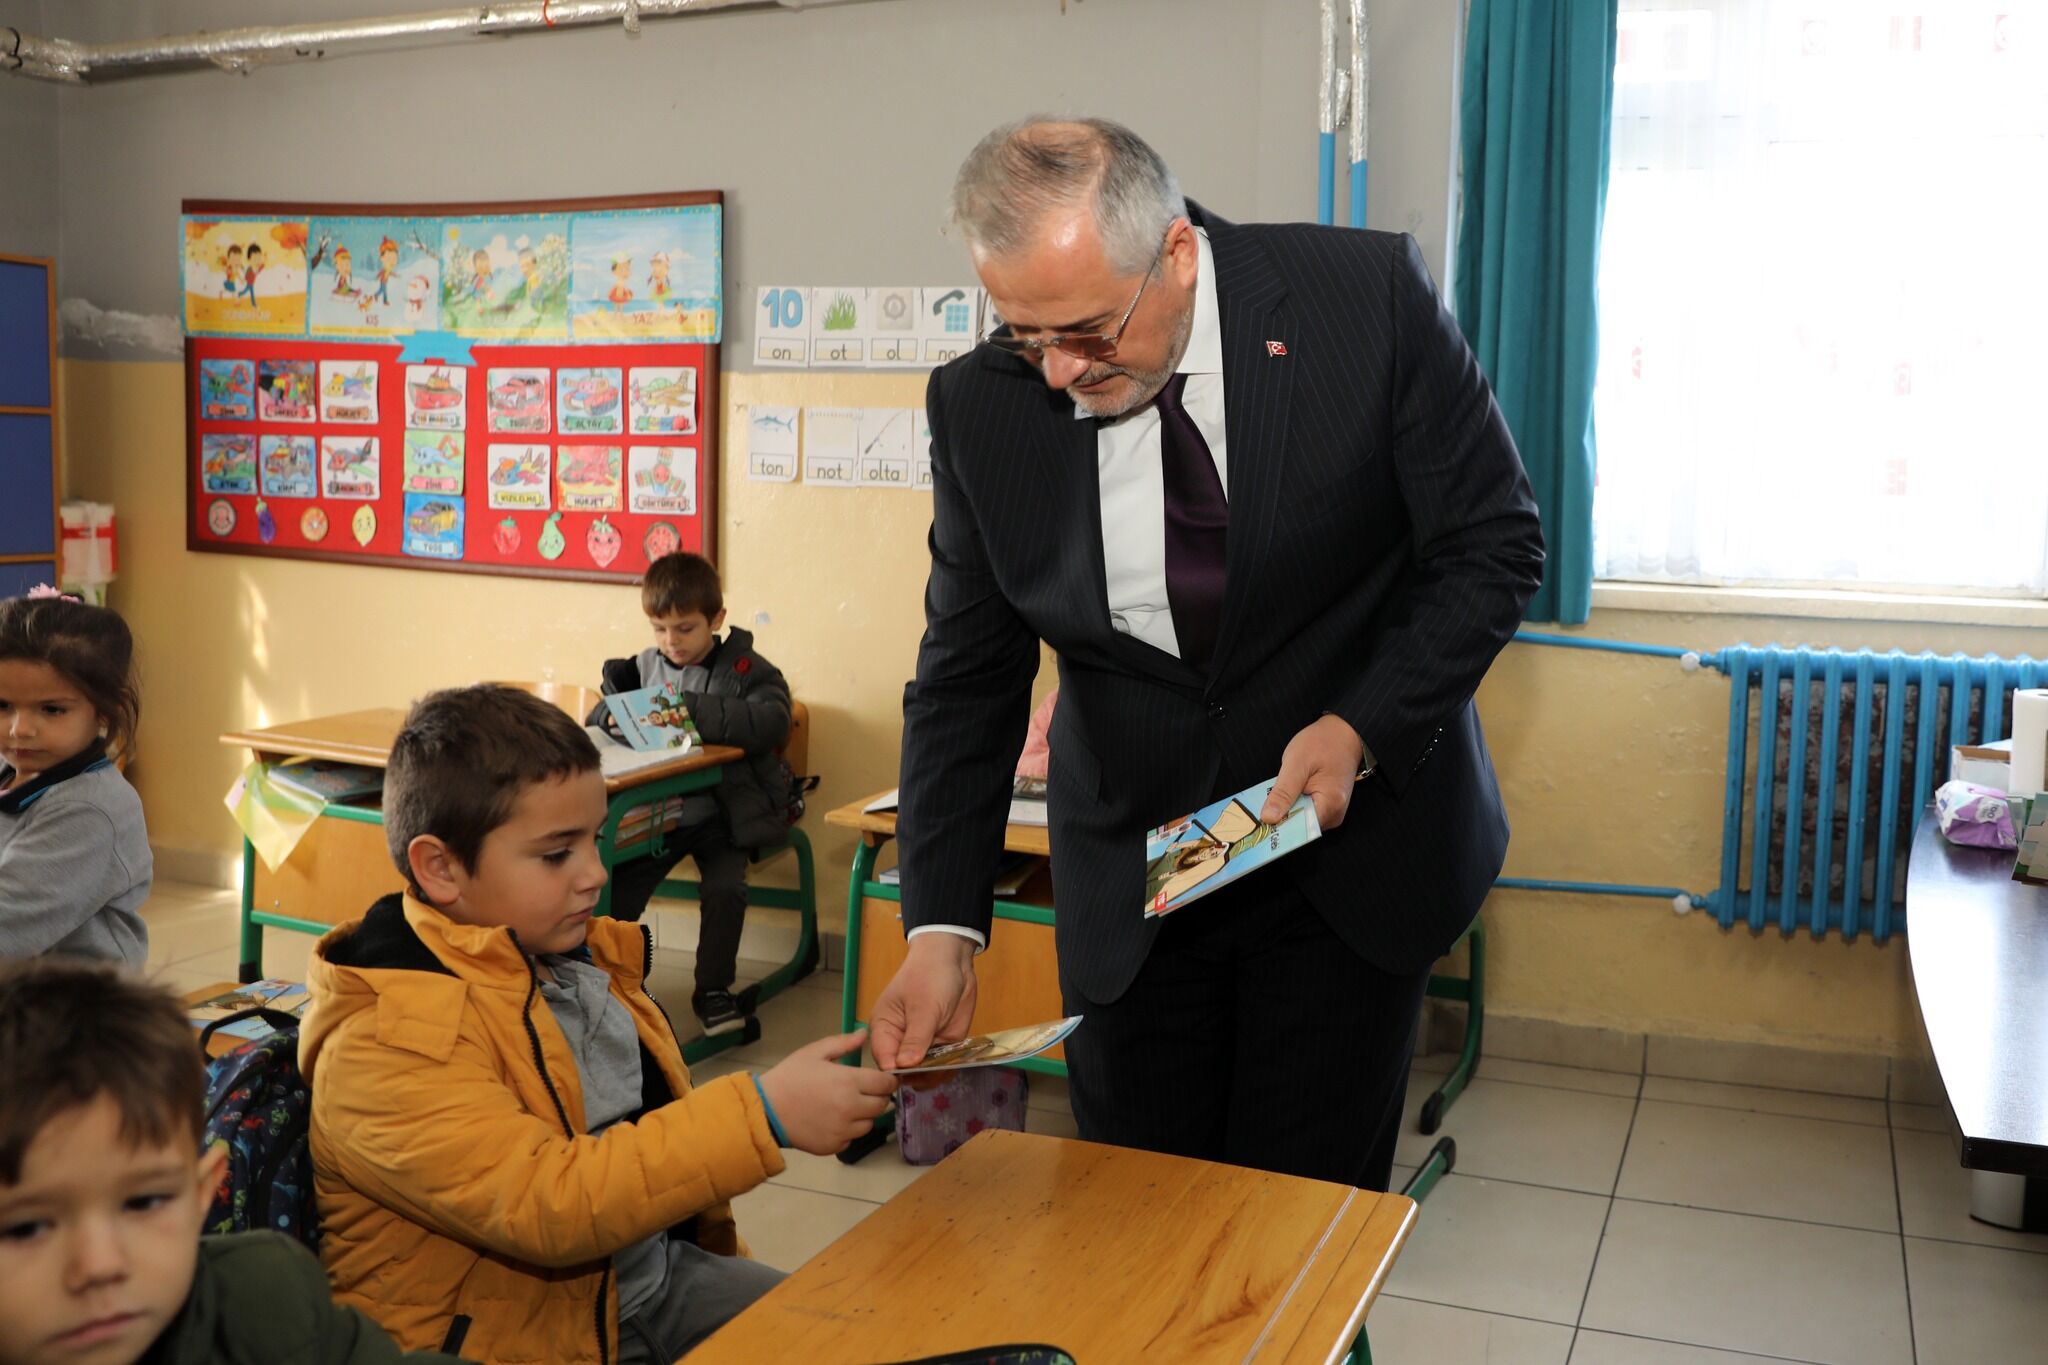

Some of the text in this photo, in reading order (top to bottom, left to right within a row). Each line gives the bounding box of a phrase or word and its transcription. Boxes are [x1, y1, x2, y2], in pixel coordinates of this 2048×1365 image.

[761, 288, 803, 329] 10
[632, 312, 654, 325] YAZ
[772, 347, 792, 360] on
[830, 343, 847, 360] ot
[886, 339, 900, 360] ol
[938, 348, 957, 360] no
[760, 458, 784, 475] ton
[817, 463, 842, 479] not
[869, 458, 900, 481] olta
